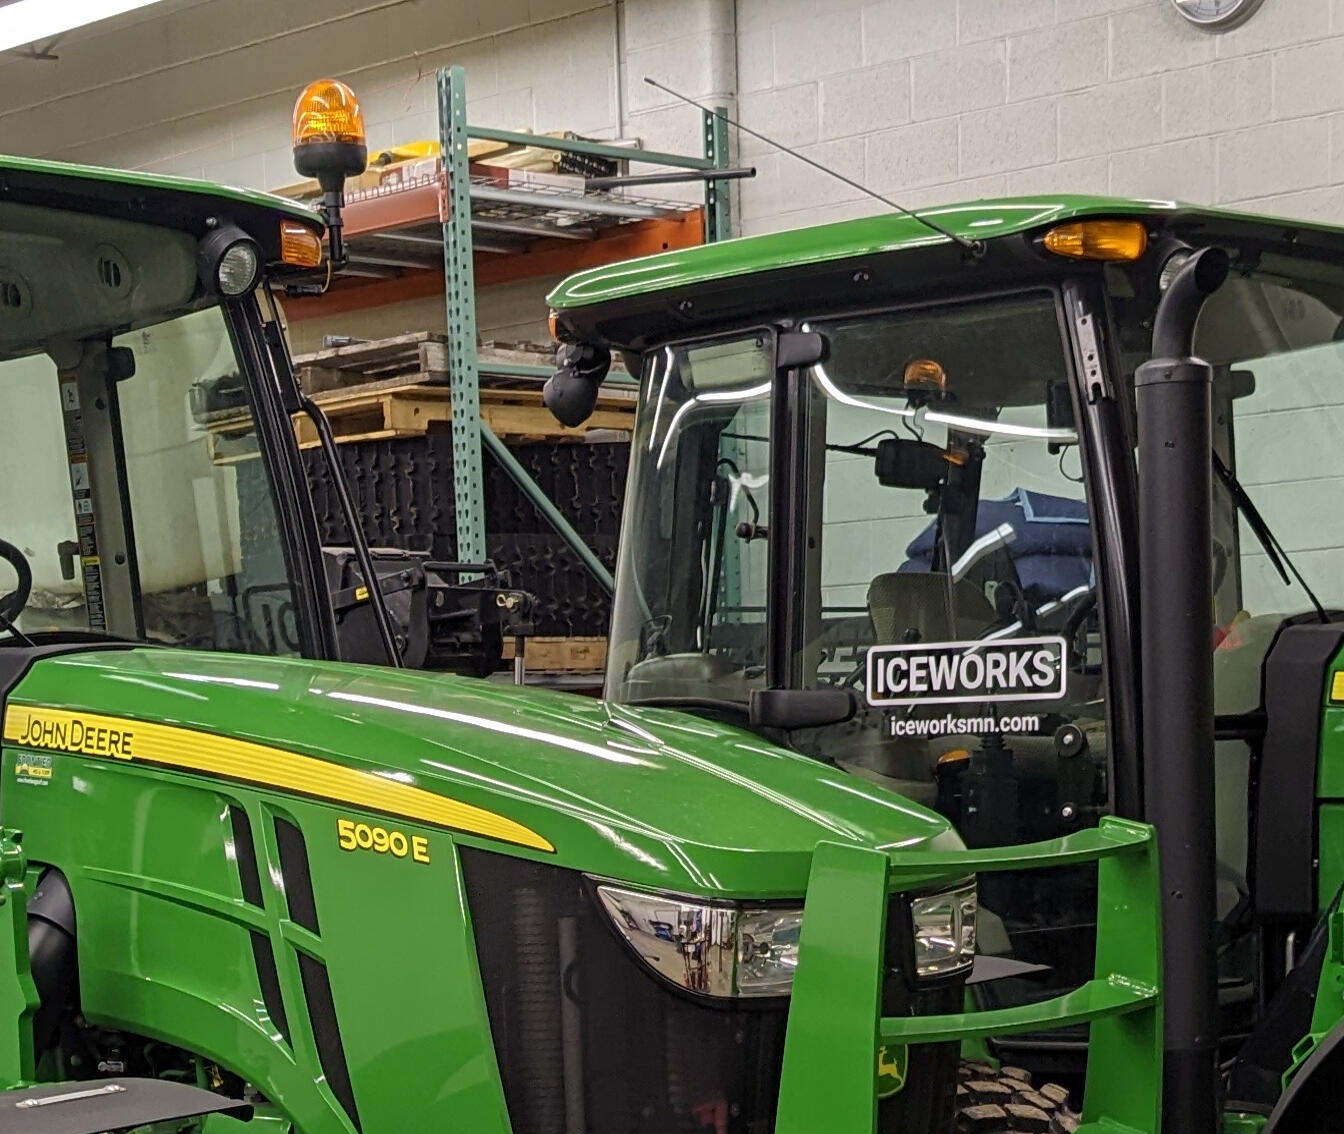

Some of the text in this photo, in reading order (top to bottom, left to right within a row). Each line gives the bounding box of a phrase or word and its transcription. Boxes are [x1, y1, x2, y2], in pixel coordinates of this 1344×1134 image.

[876, 649, 1055, 693] ICEWORKS
[20, 714, 134, 756] JOHN DEERE
[890, 713, 1039, 736] iceworksmn.com
[336, 818, 430, 865] 5090 E
